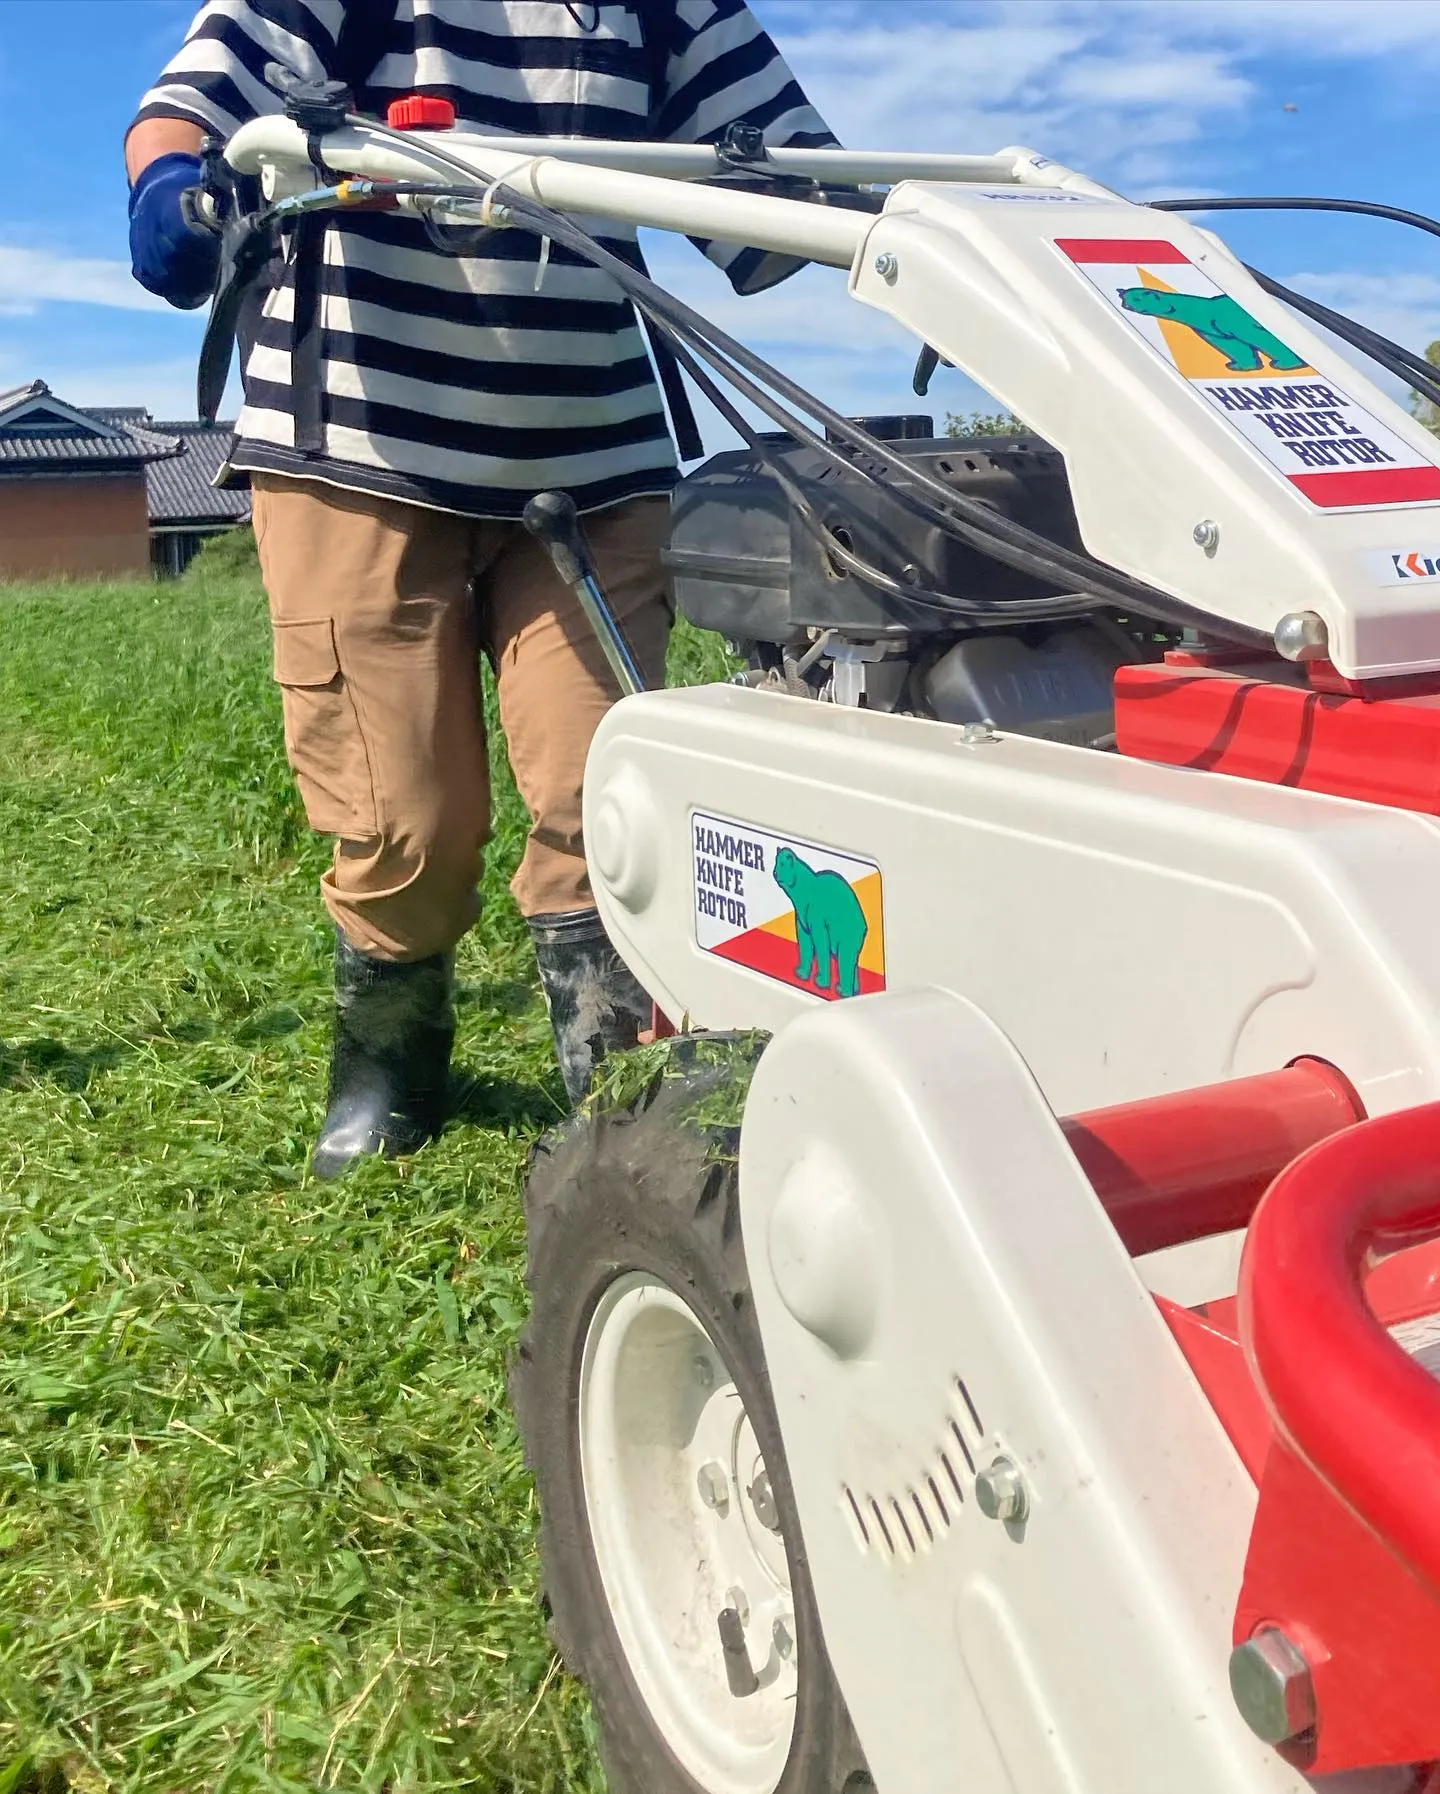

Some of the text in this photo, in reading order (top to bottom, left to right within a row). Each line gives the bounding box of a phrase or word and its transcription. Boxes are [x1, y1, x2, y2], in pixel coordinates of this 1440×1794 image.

[1206, 385, 1350, 411] HAMMER
[1254, 411, 1362, 438] KNIFE
[1281, 438, 1396, 467] ROTOR
[695, 826, 765, 872] HAMMER
[696, 857, 744, 896] KNIFE
[697, 887, 748, 929] ROTOR
